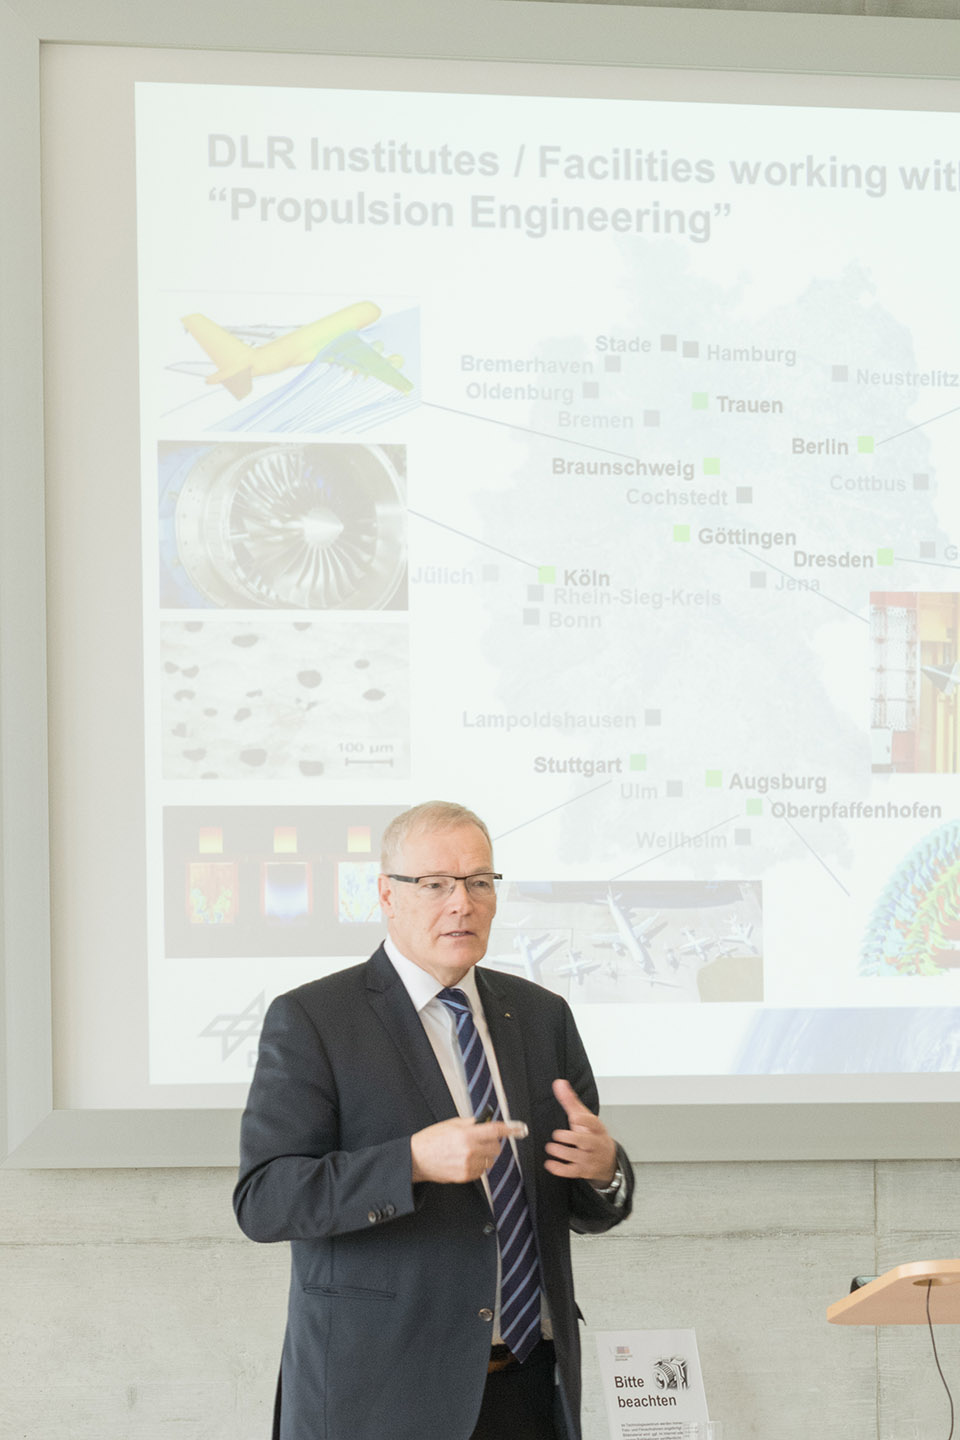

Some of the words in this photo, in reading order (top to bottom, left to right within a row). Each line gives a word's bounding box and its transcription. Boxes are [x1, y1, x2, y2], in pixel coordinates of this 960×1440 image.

[207, 133, 297, 171] DLR
[310, 136, 500, 177] Institutes
[513, 143, 526, 178] /
[538, 144, 716, 184] Facilities
[728, 154, 887, 199] working
[595, 335, 652, 353] Stade
[460, 354, 594, 375] Bremerhaven
[707, 344, 797, 368] Hamburg
[856, 368, 959, 388] Neustrelitz
[465, 381, 574, 406] Oldenburg
[716, 395, 784, 414] Trauen
[557, 410, 634, 429] Bremen
[791, 437, 849, 456] Berlin
[552, 458, 695, 480] Braunschweig
[829, 473, 907, 493] Cottbus
[625, 487, 729, 507] Cochstedt
[698, 528, 796, 548] Göttingen
[793, 550, 874, 569] Dresden
[564, 569, 610, 587] Köln
[774, 575, 820, 592] Jena
[548, 611, 603, 629] Bonn
[462, 711, 637, 731] Lampoldshausen
[338, 742, 365, 753] 100
[533, 756, 623, 779] Stuttgart
[620, 782, 658, 801] Ulm
[728, 772, 827, 795] Augsburg
[770, 801, 942, 823] Oberpfaffenhofen
[614, 1375, 645, 1388] Bitte
[617, 1395, 677, 1408] beachten
